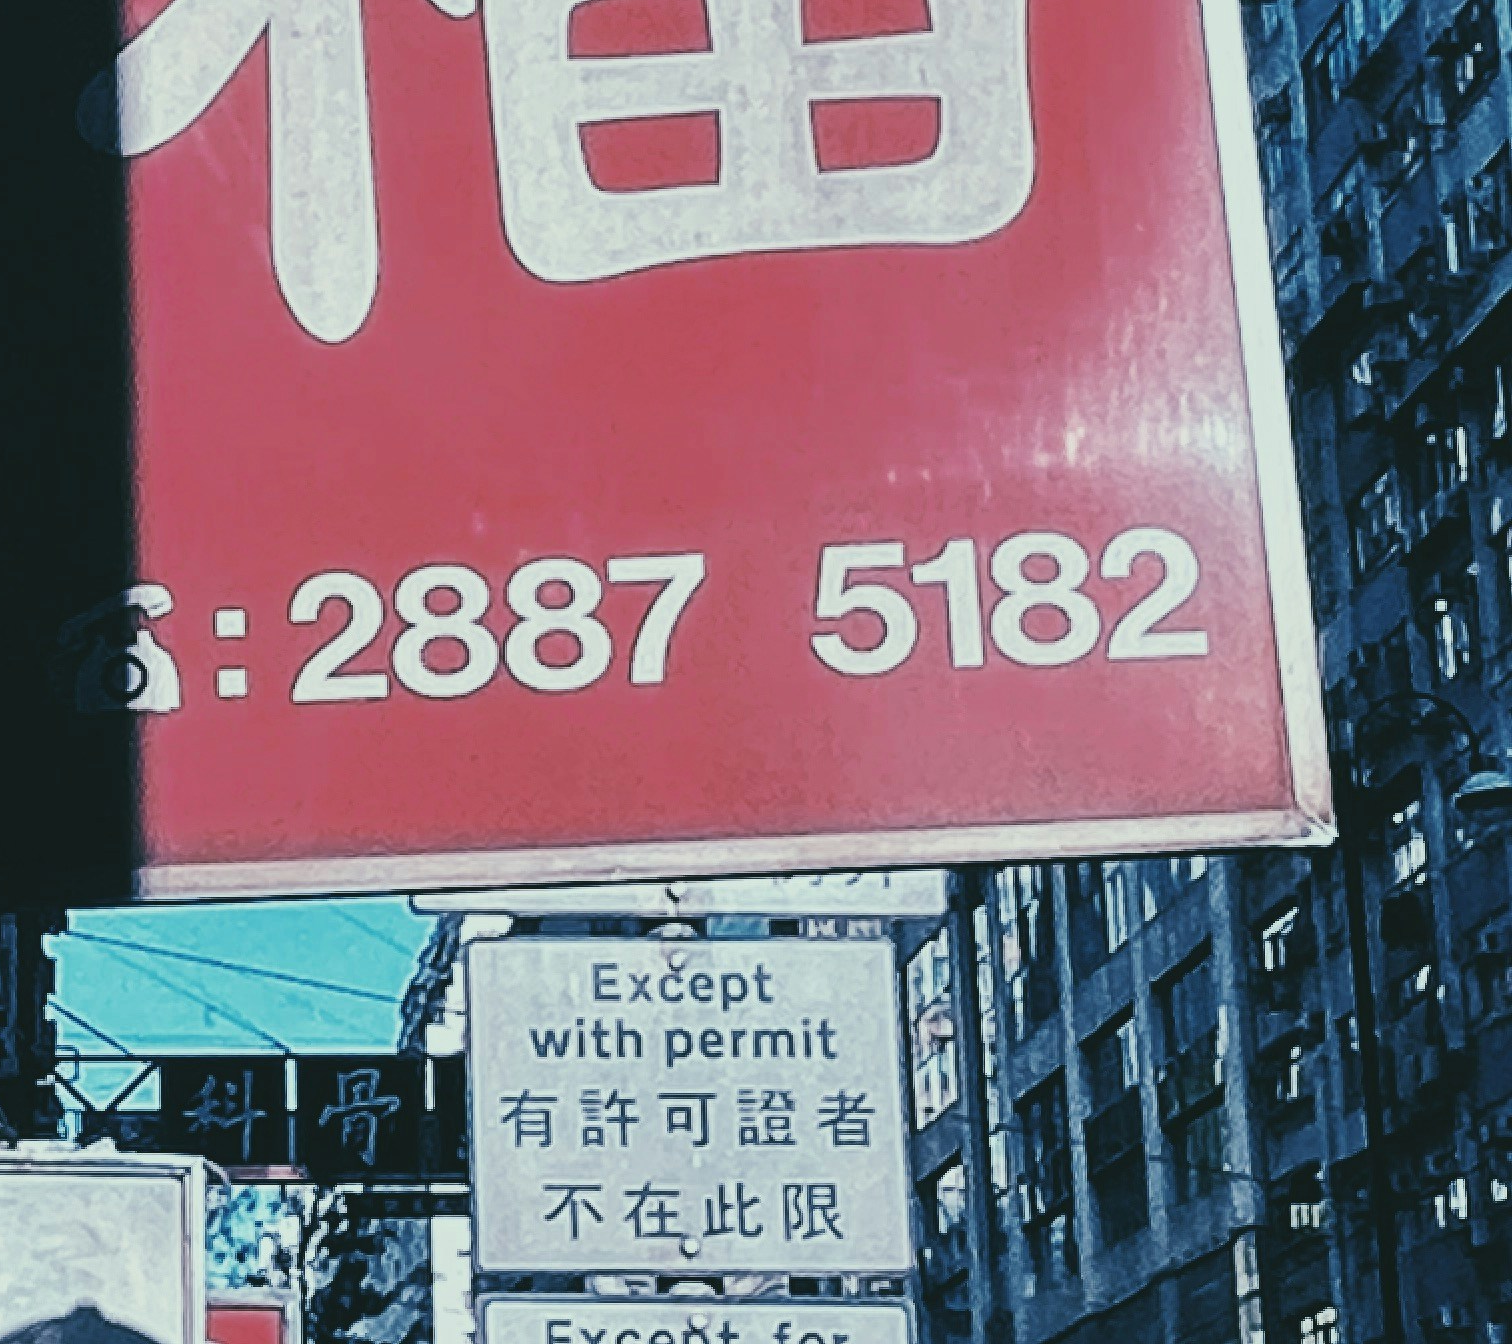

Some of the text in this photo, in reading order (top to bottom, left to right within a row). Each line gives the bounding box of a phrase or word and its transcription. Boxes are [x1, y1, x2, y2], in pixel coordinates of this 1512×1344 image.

[287, 551, 707, 706] 2887
[808, 525, 1210, 678] 5182
[591, 961, 775, 1011] Except
[529, 1019, 839, 1068] with permit
[498, 1087, 876, 1149] 有許可證者
[542, 1181, 845, 1242] 不在此限
